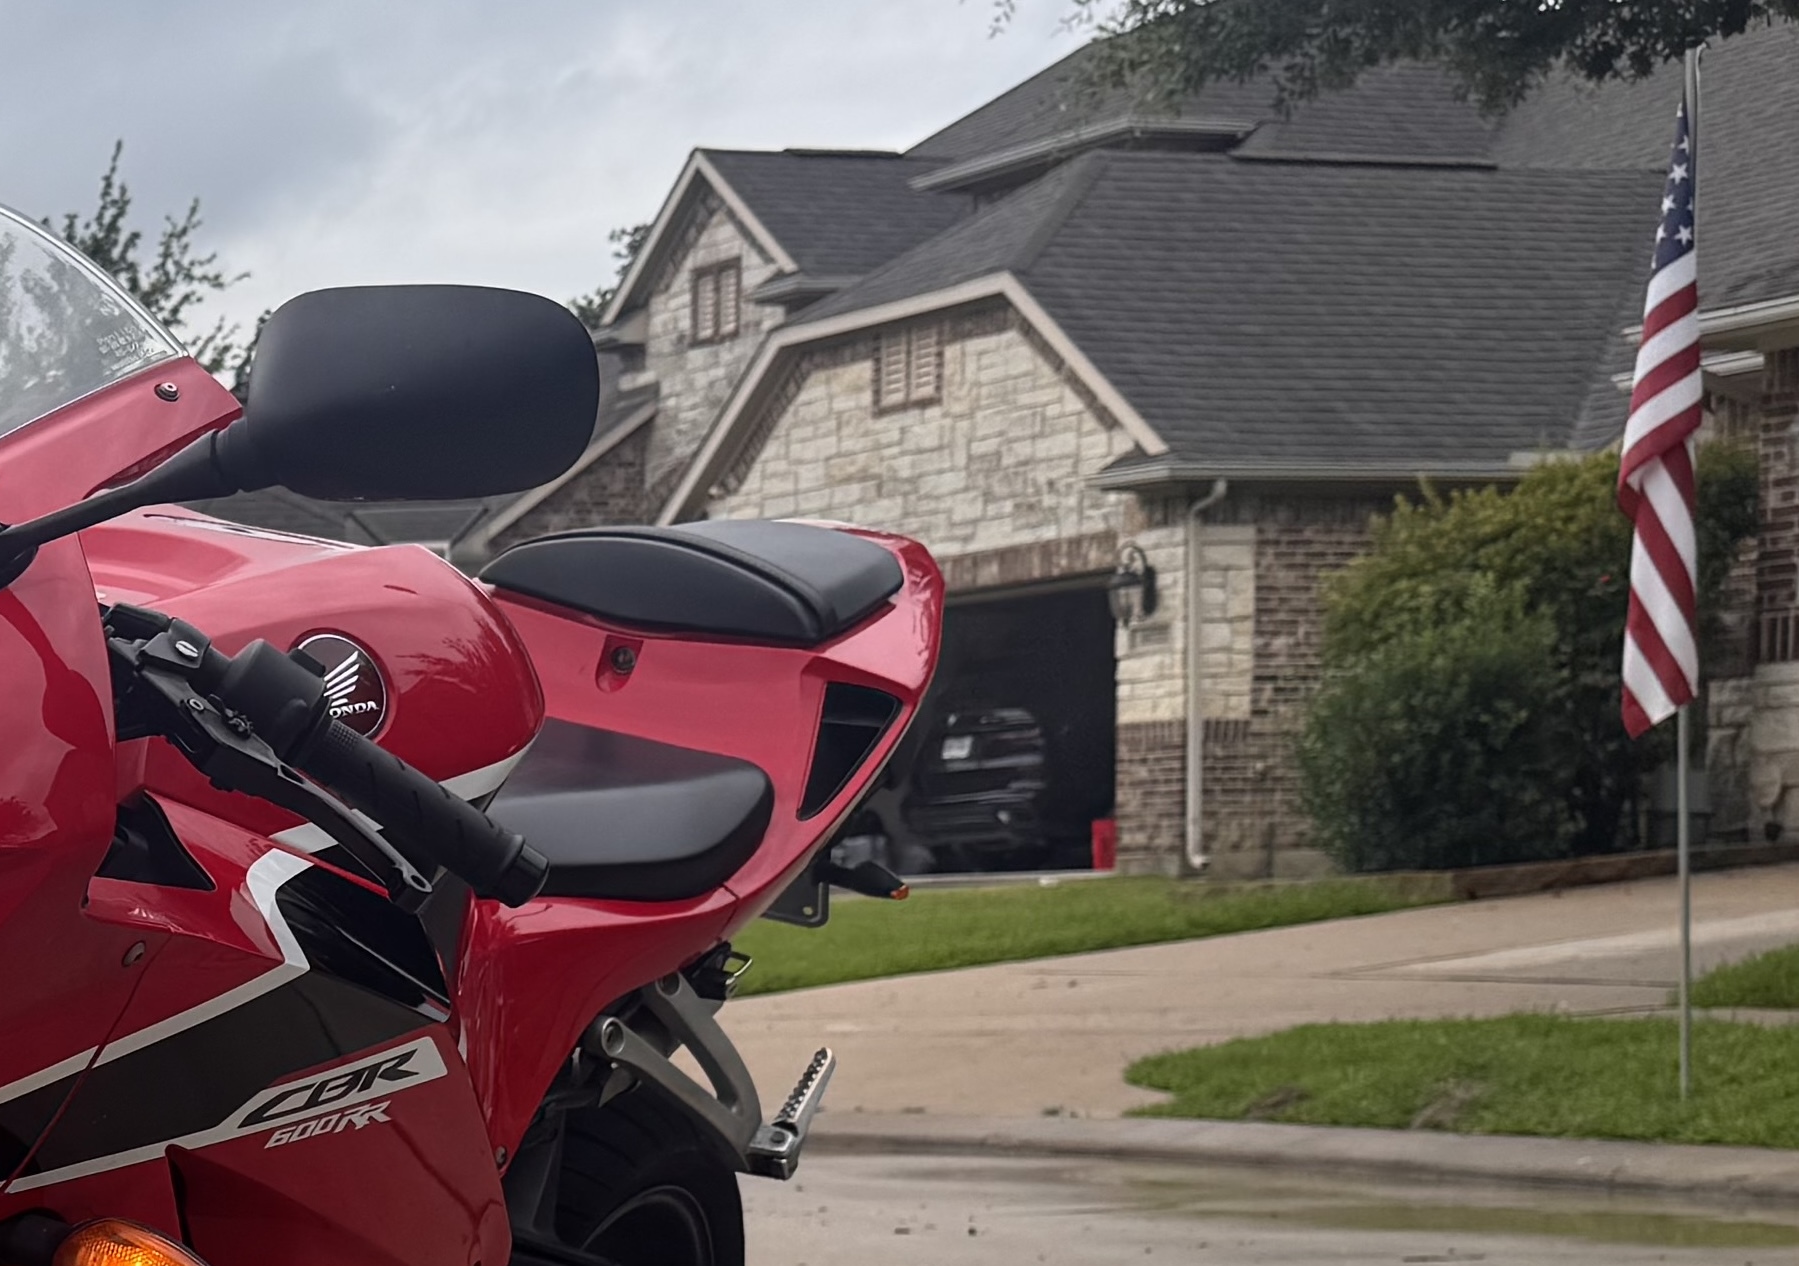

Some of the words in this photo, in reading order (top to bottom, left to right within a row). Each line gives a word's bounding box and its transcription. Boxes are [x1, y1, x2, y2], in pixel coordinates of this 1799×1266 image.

[328, 700, 380, 719] ONDA
[237, 1048, 420, 1129] CBR
[264, 1100, 393, 1149] 600RR
